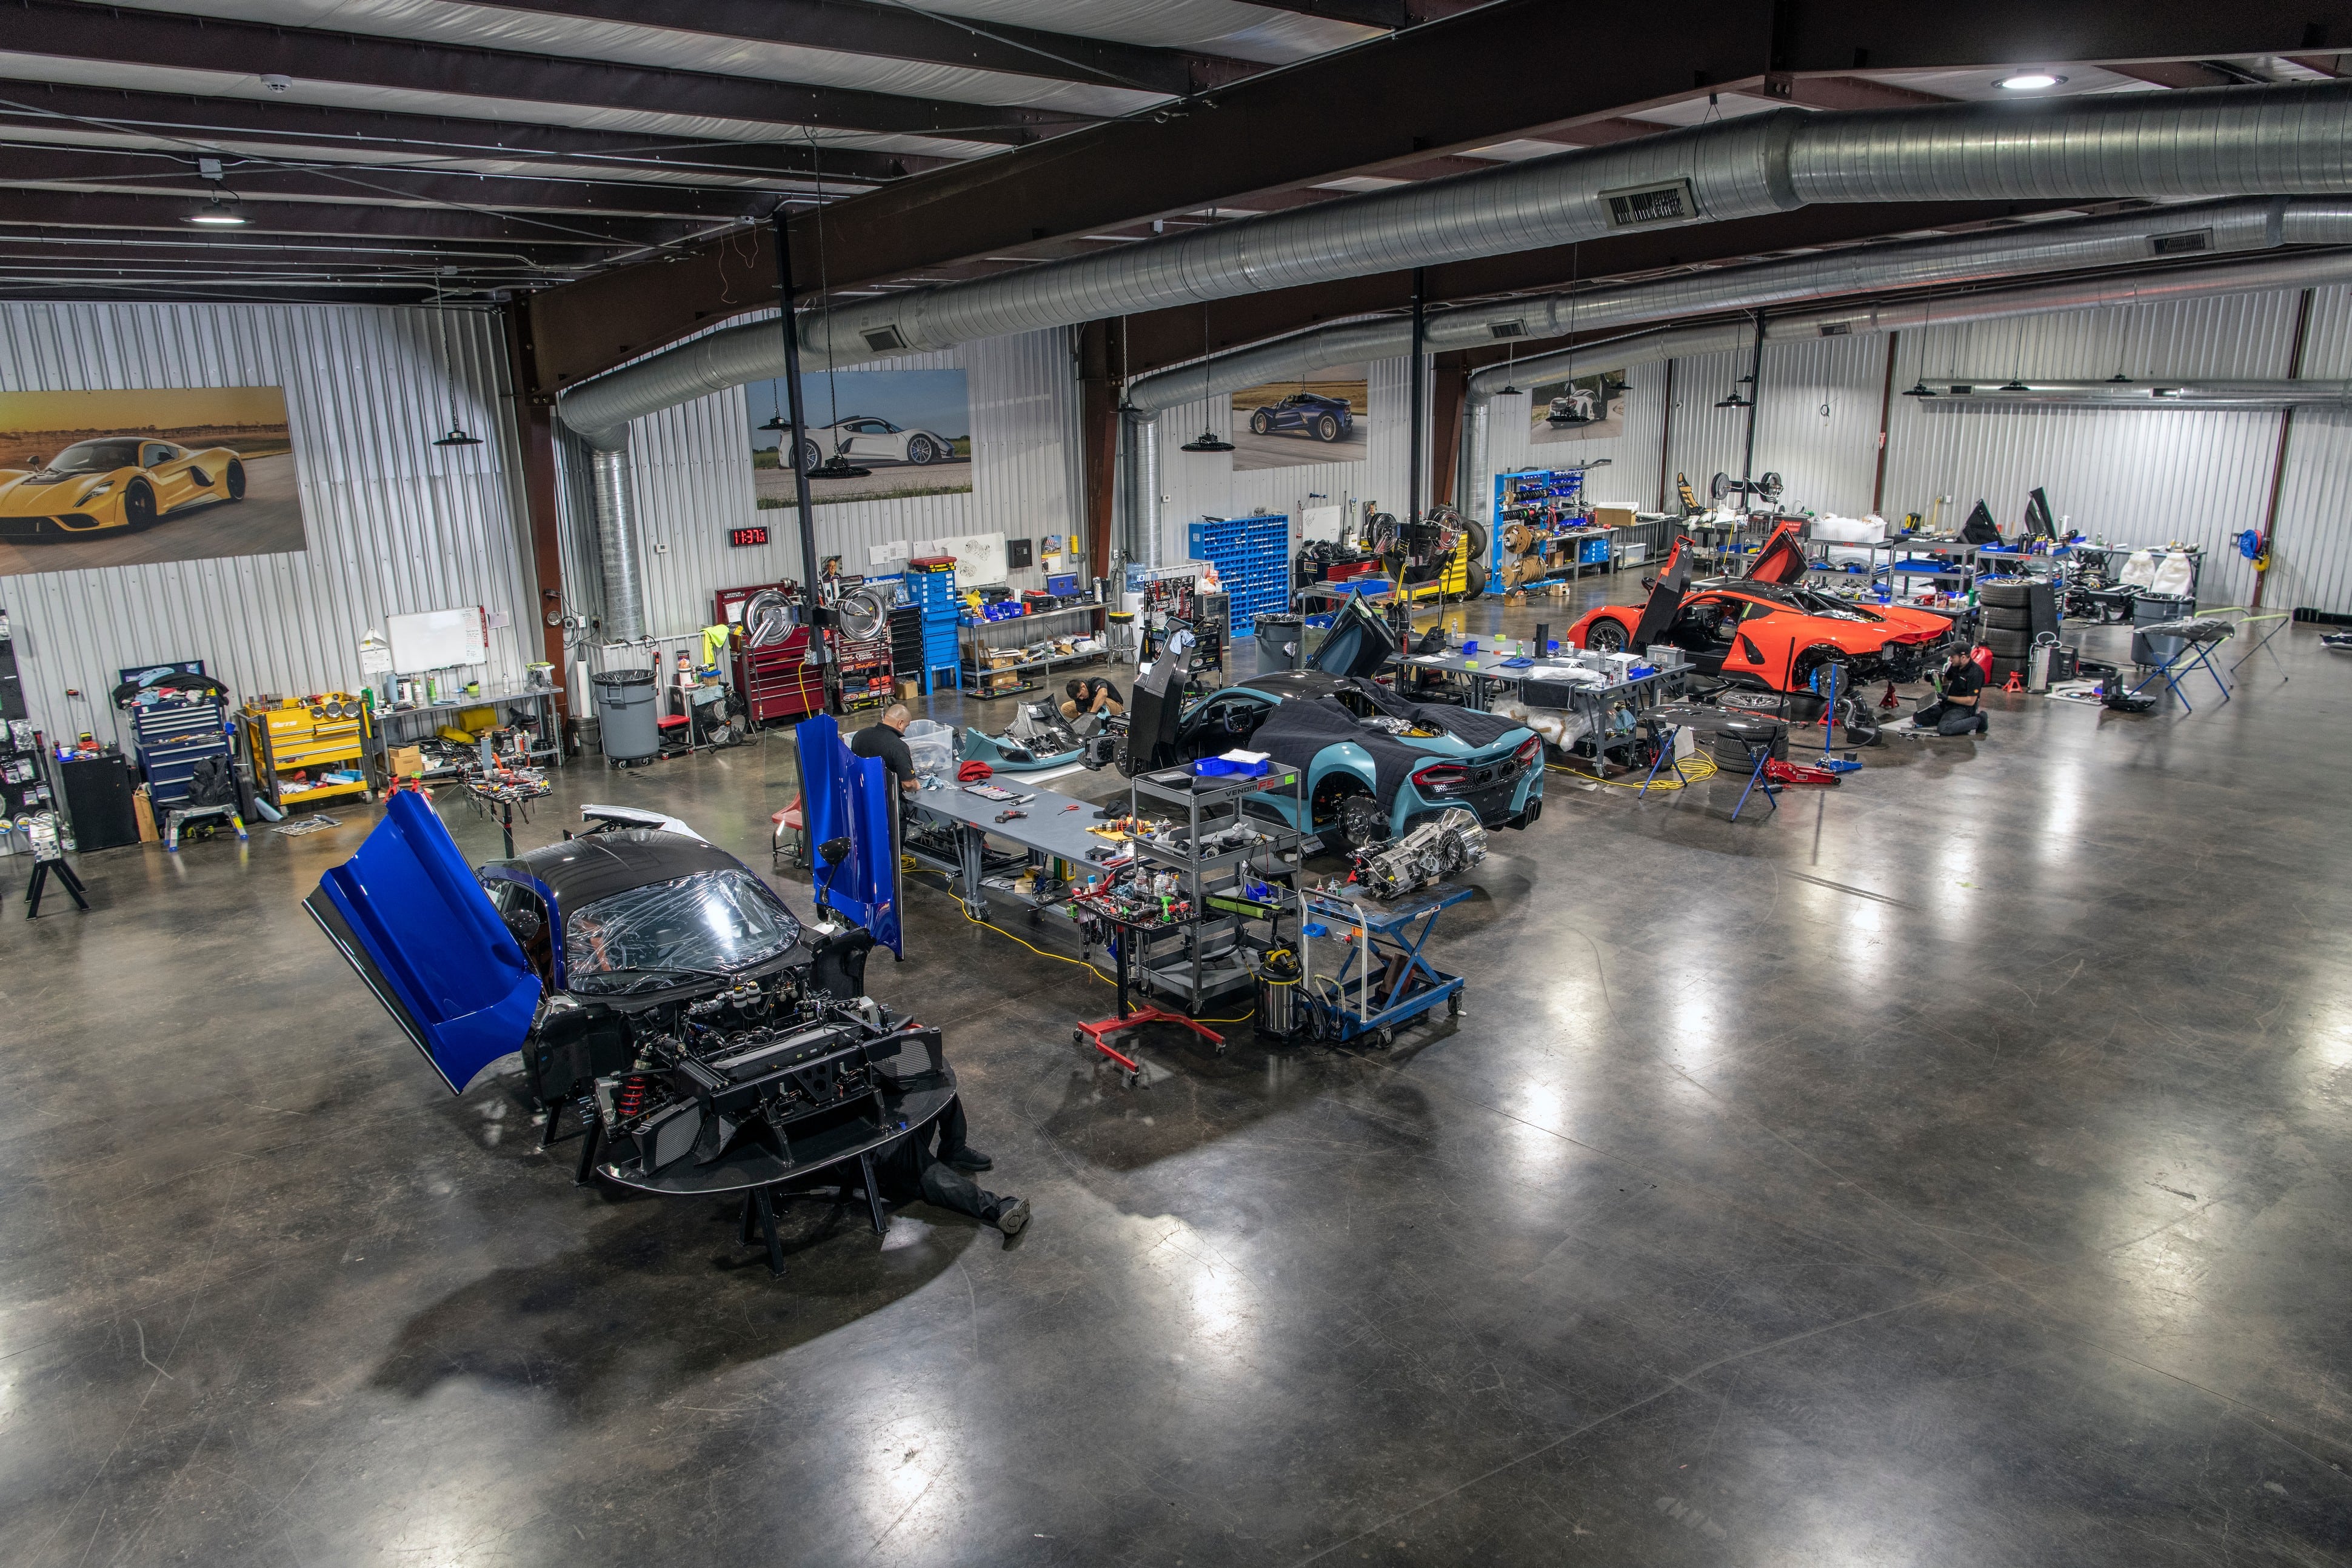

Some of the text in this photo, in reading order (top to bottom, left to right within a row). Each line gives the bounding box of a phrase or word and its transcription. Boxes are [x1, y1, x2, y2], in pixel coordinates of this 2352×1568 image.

[735, 529, 759, 544] 11:37
[1224, 778, 1275, 797] VENOM F5
